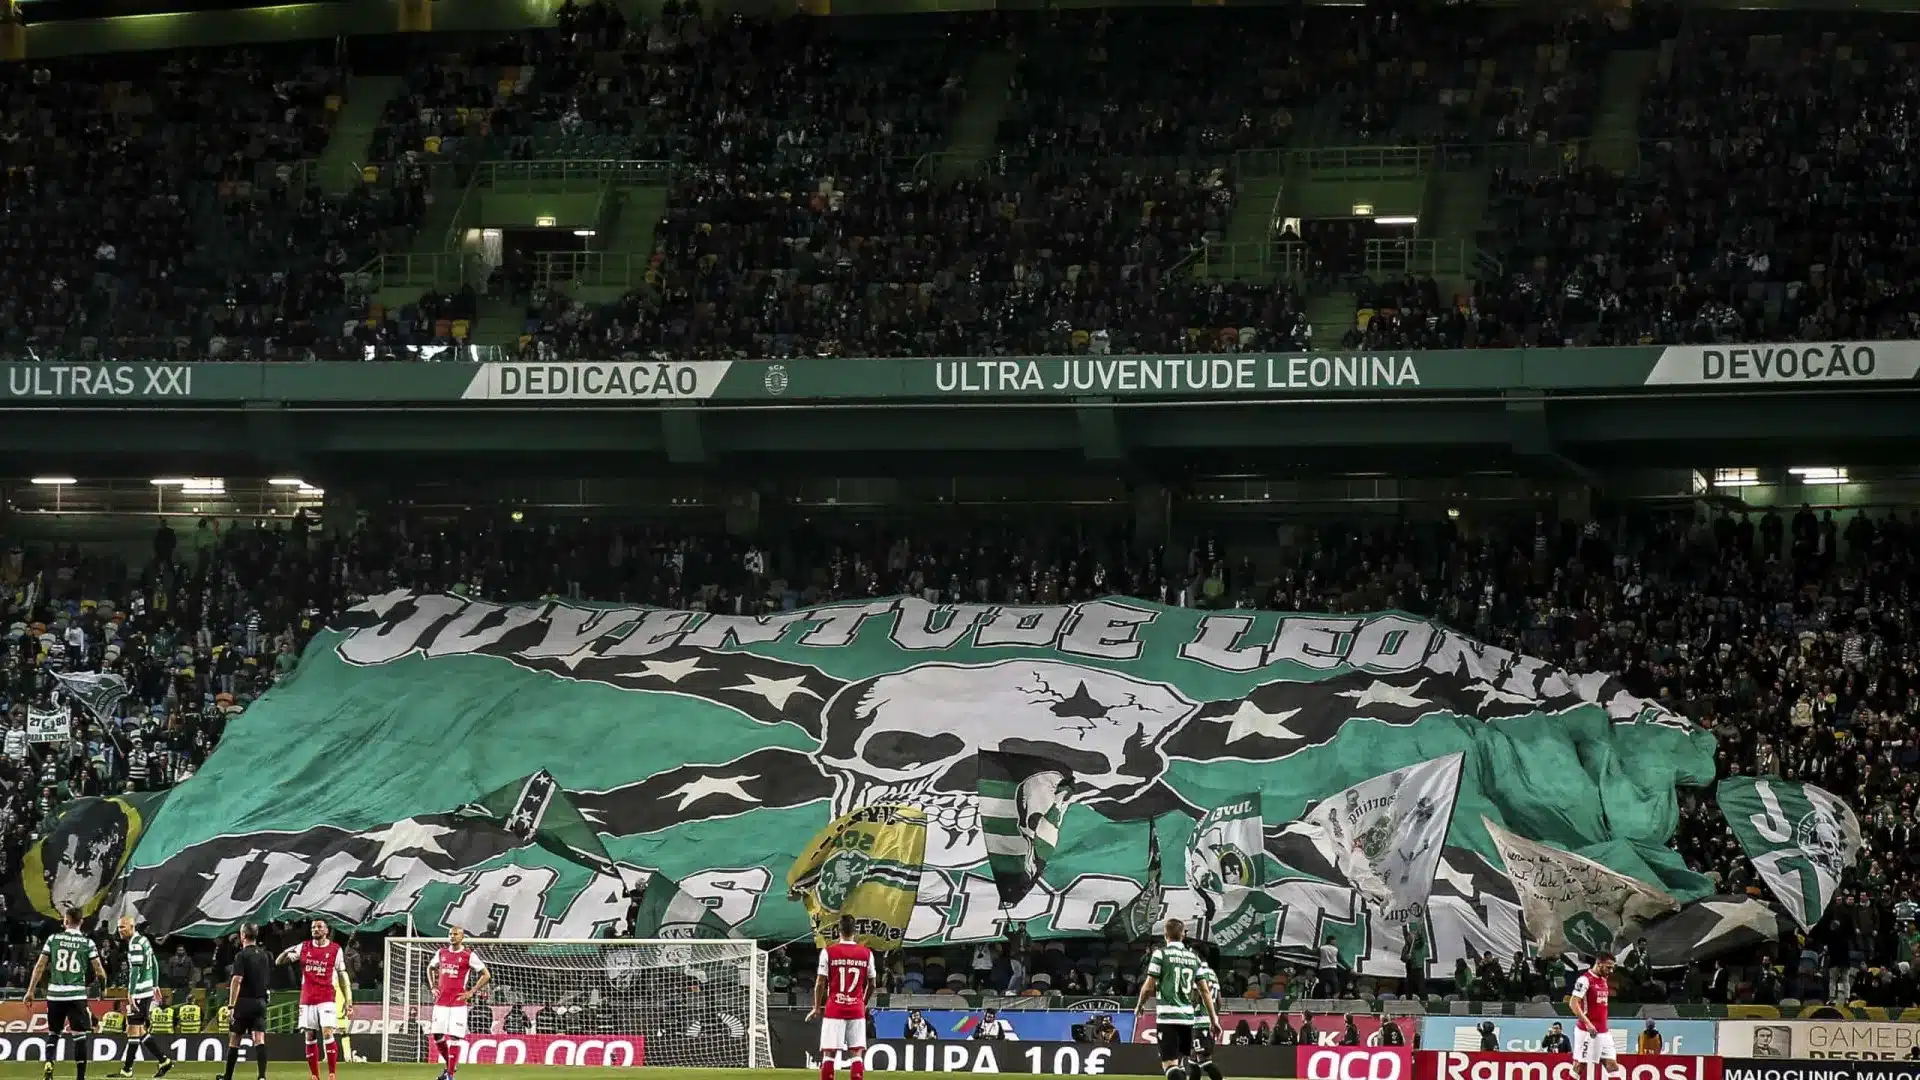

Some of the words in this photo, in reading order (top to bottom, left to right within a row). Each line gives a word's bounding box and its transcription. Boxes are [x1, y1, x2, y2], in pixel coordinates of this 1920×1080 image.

[936, 361, 1045, 391] ULTRA
[1052, 359, 1256, 390] JUVENTUDE
[1267, 356, 1421, 388] LEONINA
[1702, 344, 1876, 379] DEVOÇÃO
[10, 366, 135, 396] ULTRAS
[143, 366, 192, 395] XXI
[502, 361, 697, 397] DEDICAÇÃO
[335, 593, 1161, 665] JUVENTUDE
[55, 948, 81, 974] 86
[838, 966, 861, 993] 17
[1174, 966, 1194, 995] 13
[1024, 1045, 1113, 1076] 10€
